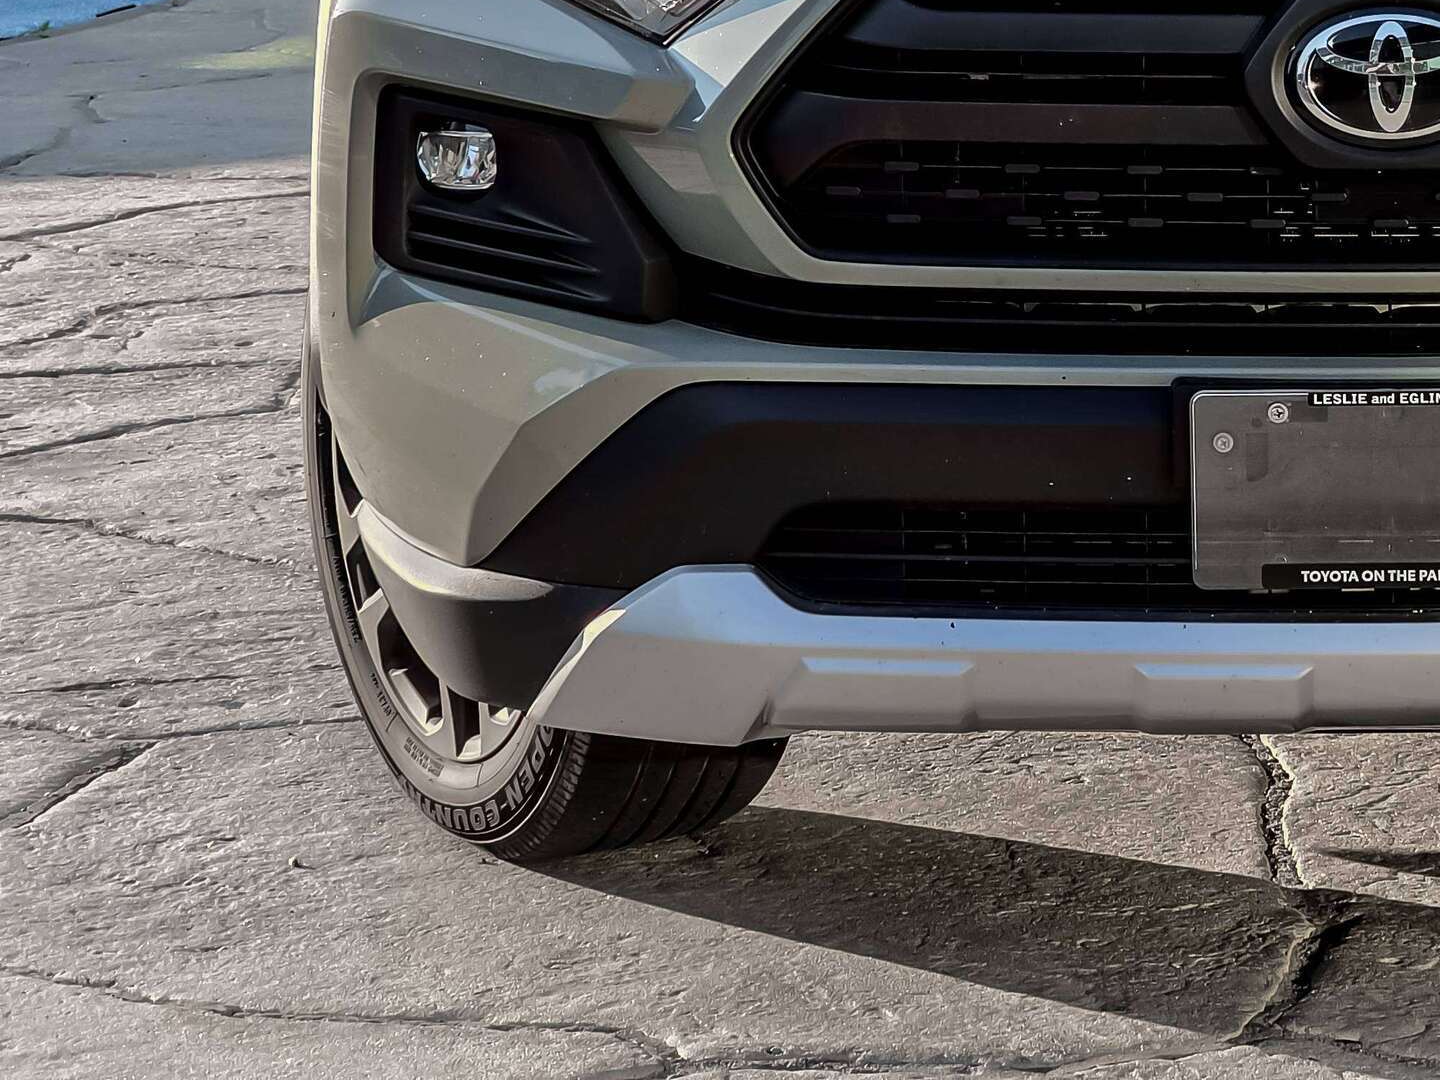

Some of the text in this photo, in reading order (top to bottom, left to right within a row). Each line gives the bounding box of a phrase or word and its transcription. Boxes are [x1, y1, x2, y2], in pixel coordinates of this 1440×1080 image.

[1313, 393, 1368, 405] LESLIE
[1371, 392, 1395, 405] and
[1300, 569, 1359, 583] TOYOTA
[1361, 569, 1385, 582] ON
[1387, 569, 1416, 582] THE
